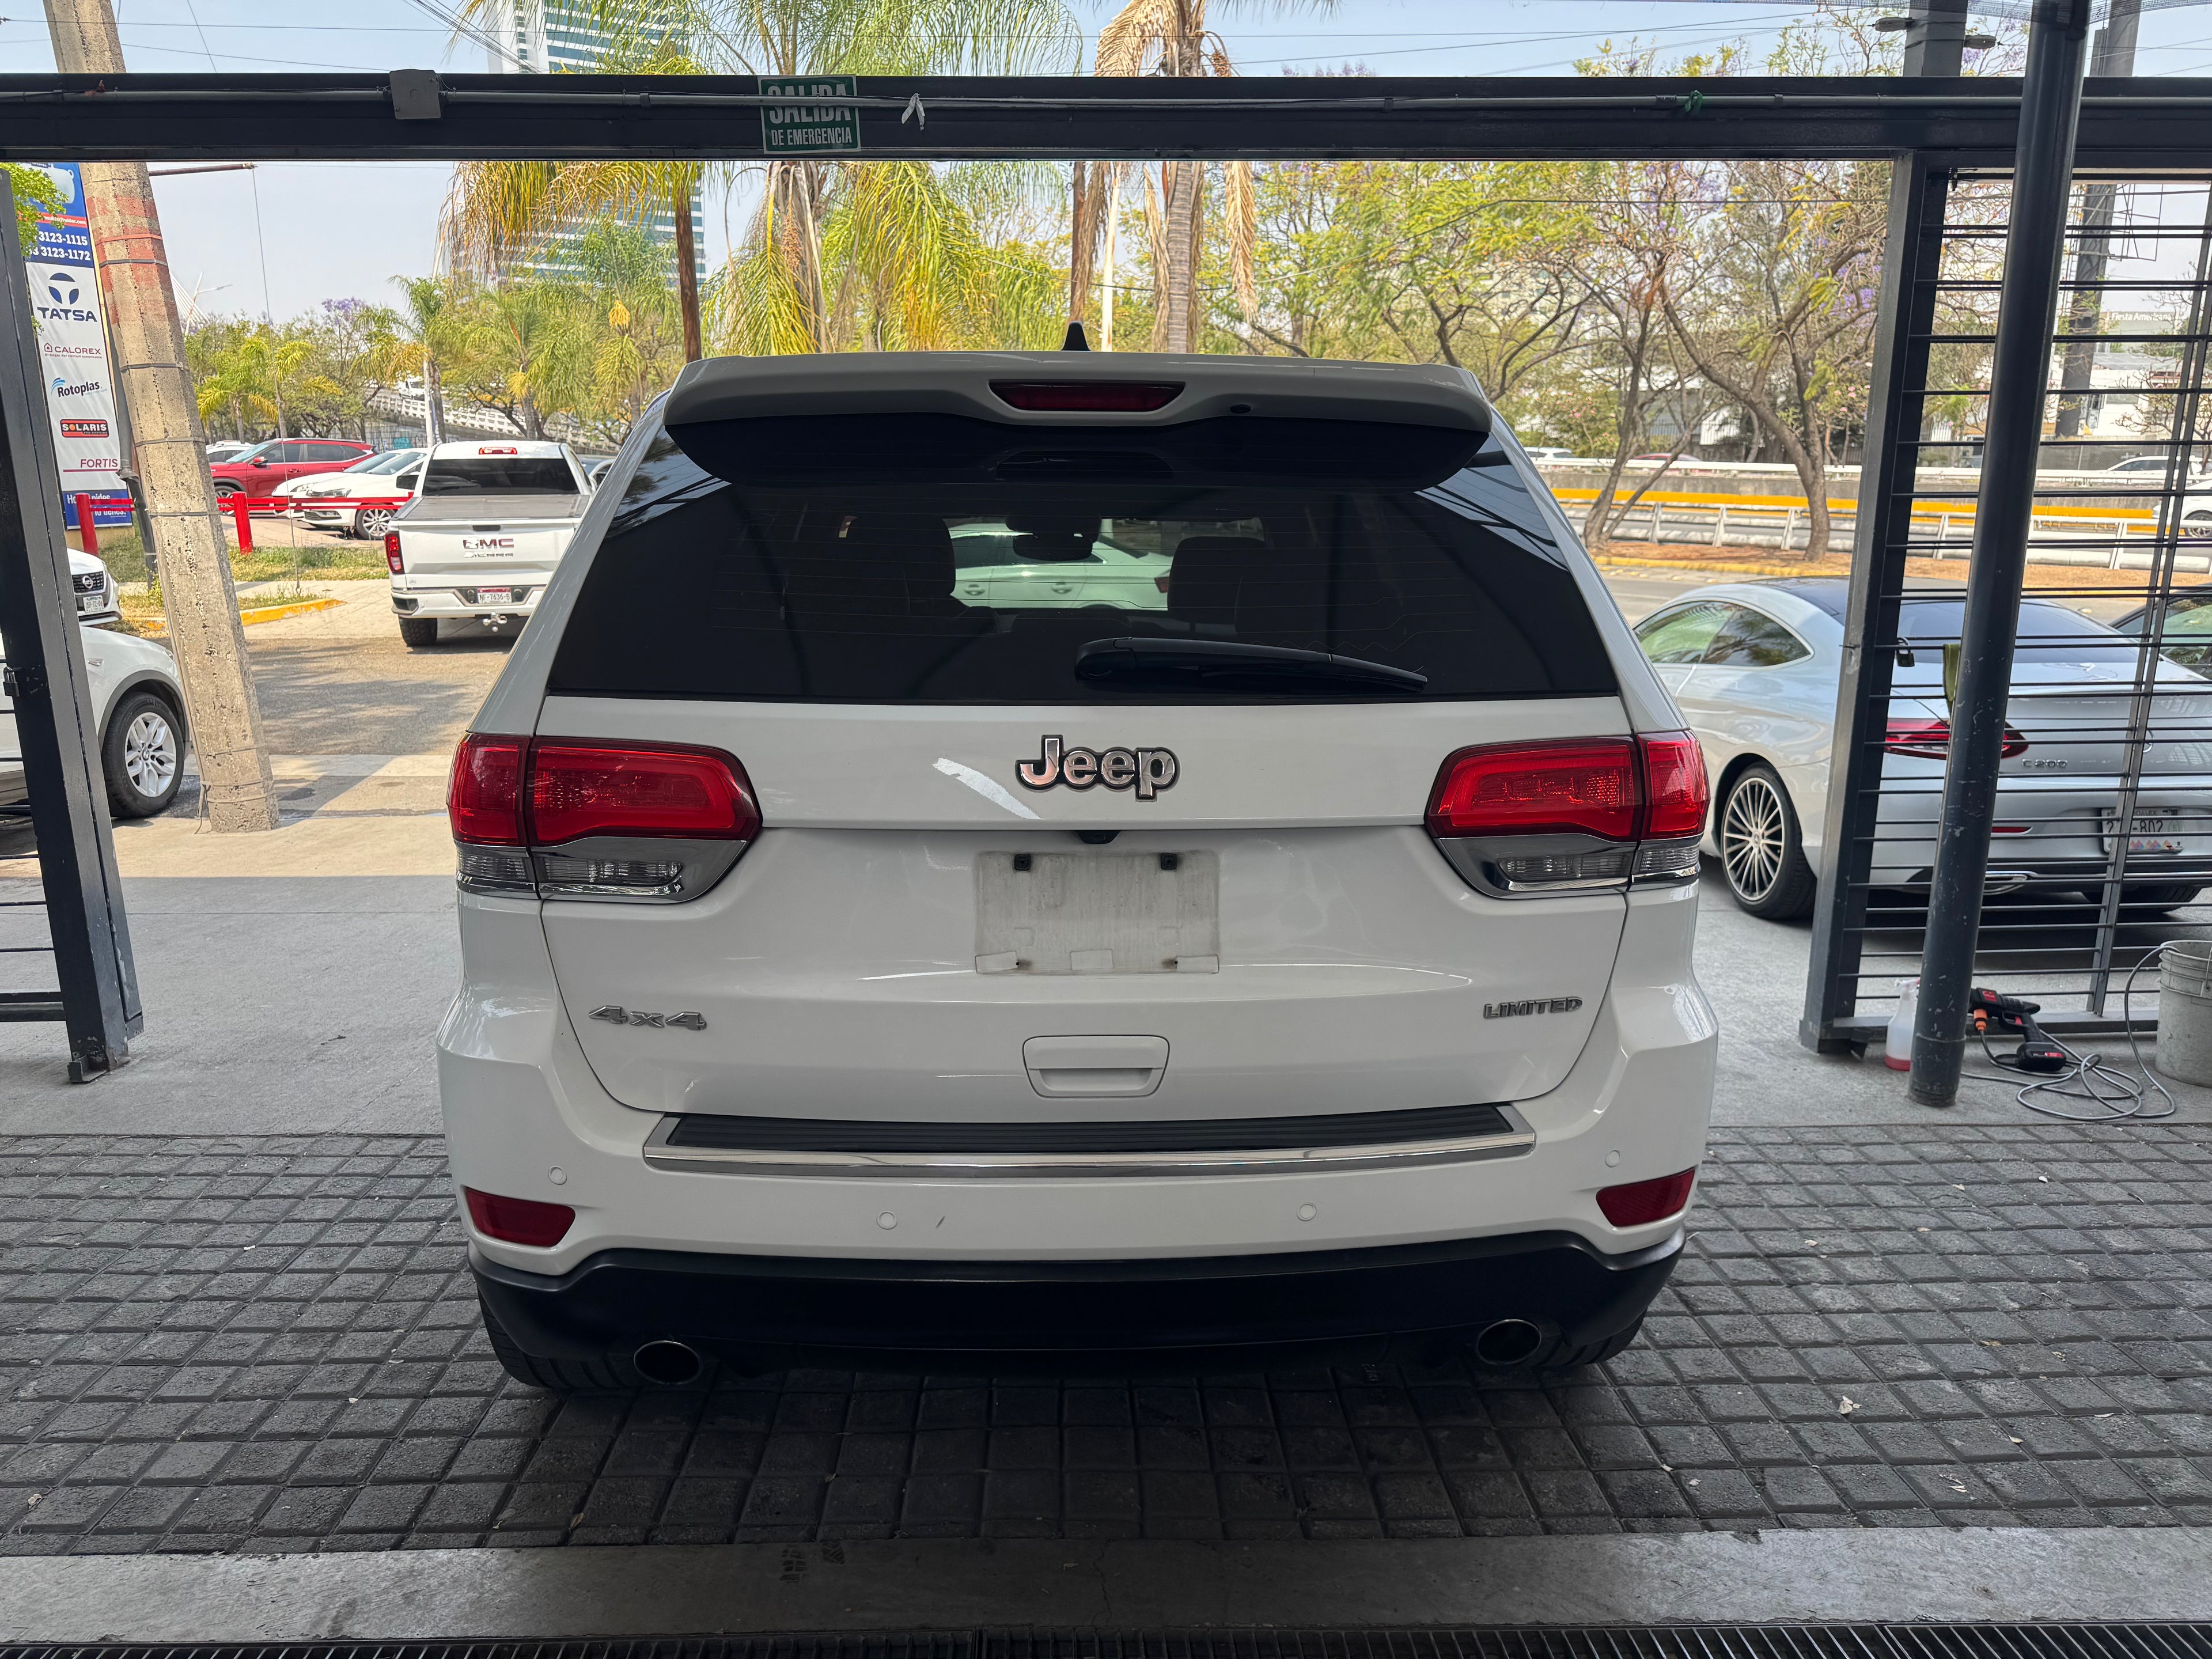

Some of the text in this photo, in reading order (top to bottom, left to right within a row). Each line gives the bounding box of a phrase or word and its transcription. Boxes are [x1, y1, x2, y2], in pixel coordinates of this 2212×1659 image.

[767, 84, 851, 124] SALIDA
[771, 127, 853, 146] DE EMERGENCIA
[38, 231, 88, 246] 3123-1115
[41, 246, 91, 261] 3123-1172
[37, 306, 98, 323] TATSA
[2111, 312, 2172, 321] Fiesta Americana
[55, 346, 101, 355] CALOREX
[58, 381, 100, 397] Rotoplas
[62, 423, 107, 431] SOLARIS
[81, 459, 118, 468] FORTIS
[463, 539, 514, 549] GMC
[1016, 735, 1179, 800] Jeep
[2022, 758, 2068, 768] C 200
[1483, 997, 1583, 1019] LIMITED
